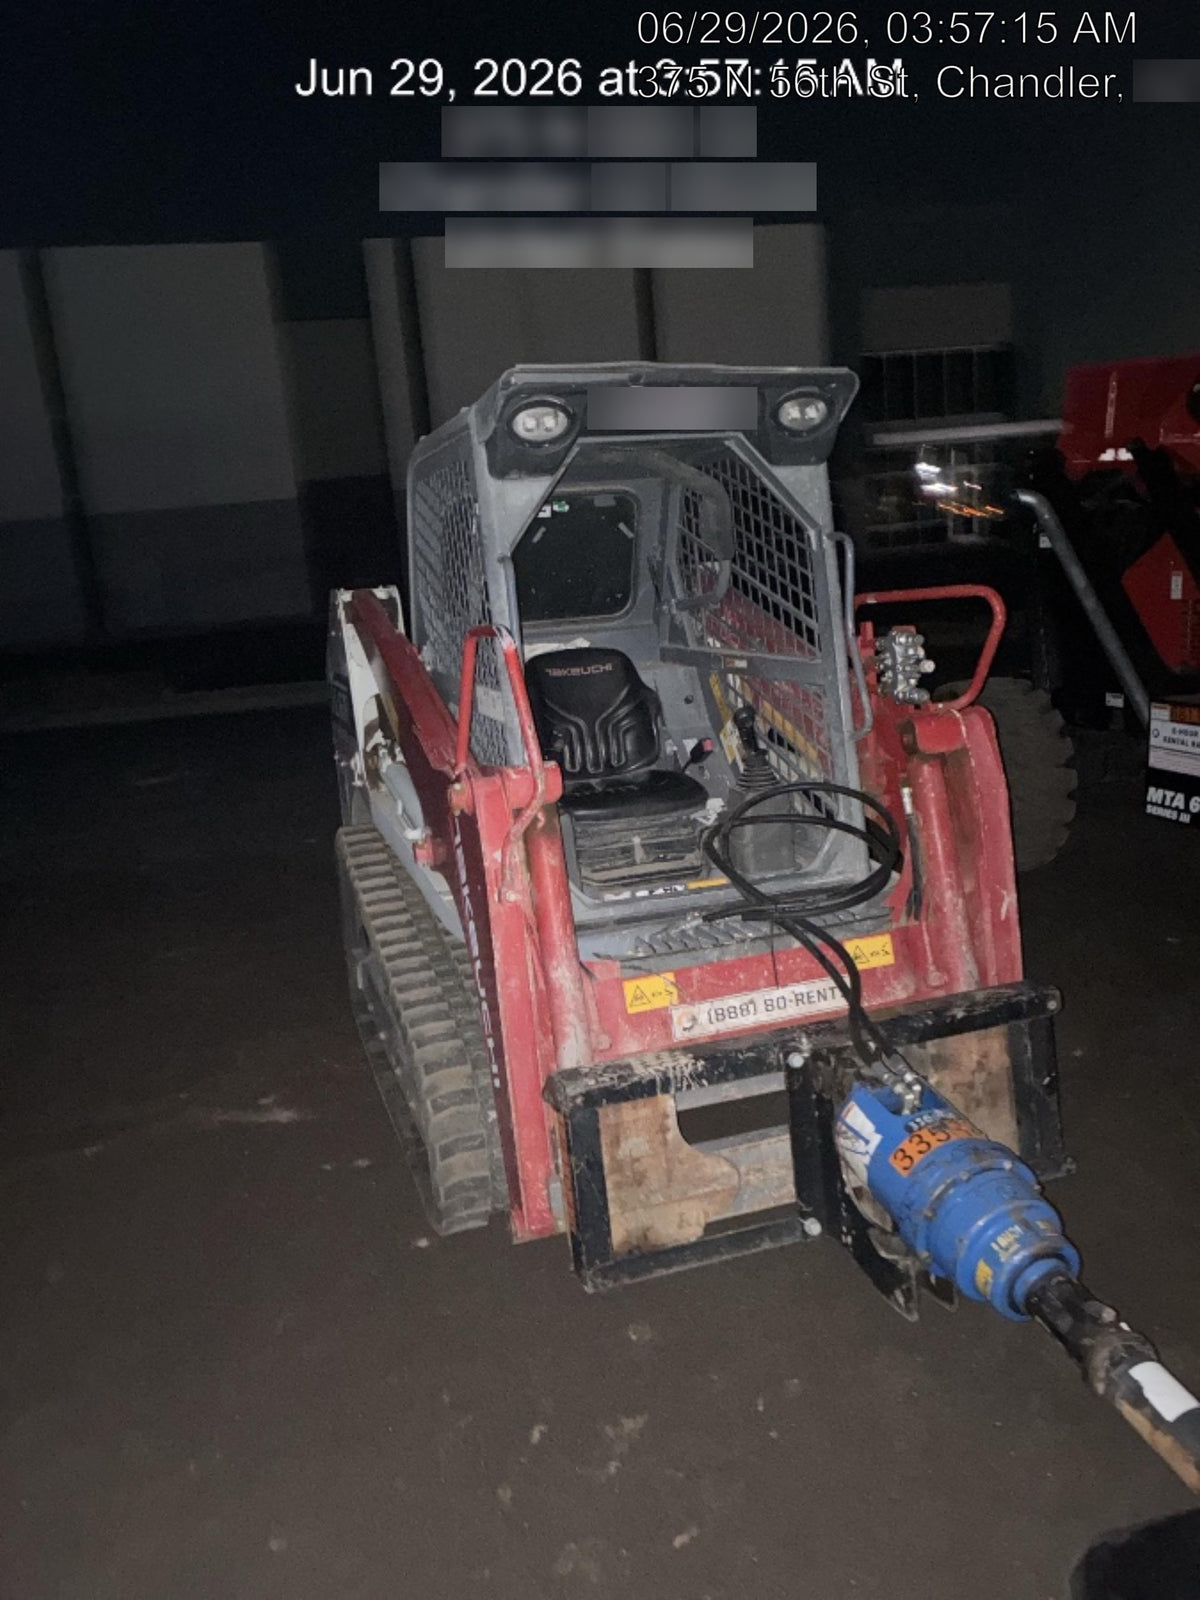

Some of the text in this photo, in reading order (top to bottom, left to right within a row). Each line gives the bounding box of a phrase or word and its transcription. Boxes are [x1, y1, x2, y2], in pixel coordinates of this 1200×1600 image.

[545, 662, 613, 677] TAKEUCHI
[1146, 786, 1185, 810] MTA
[706, 986, 845, 1025] (888) 80-RENT
